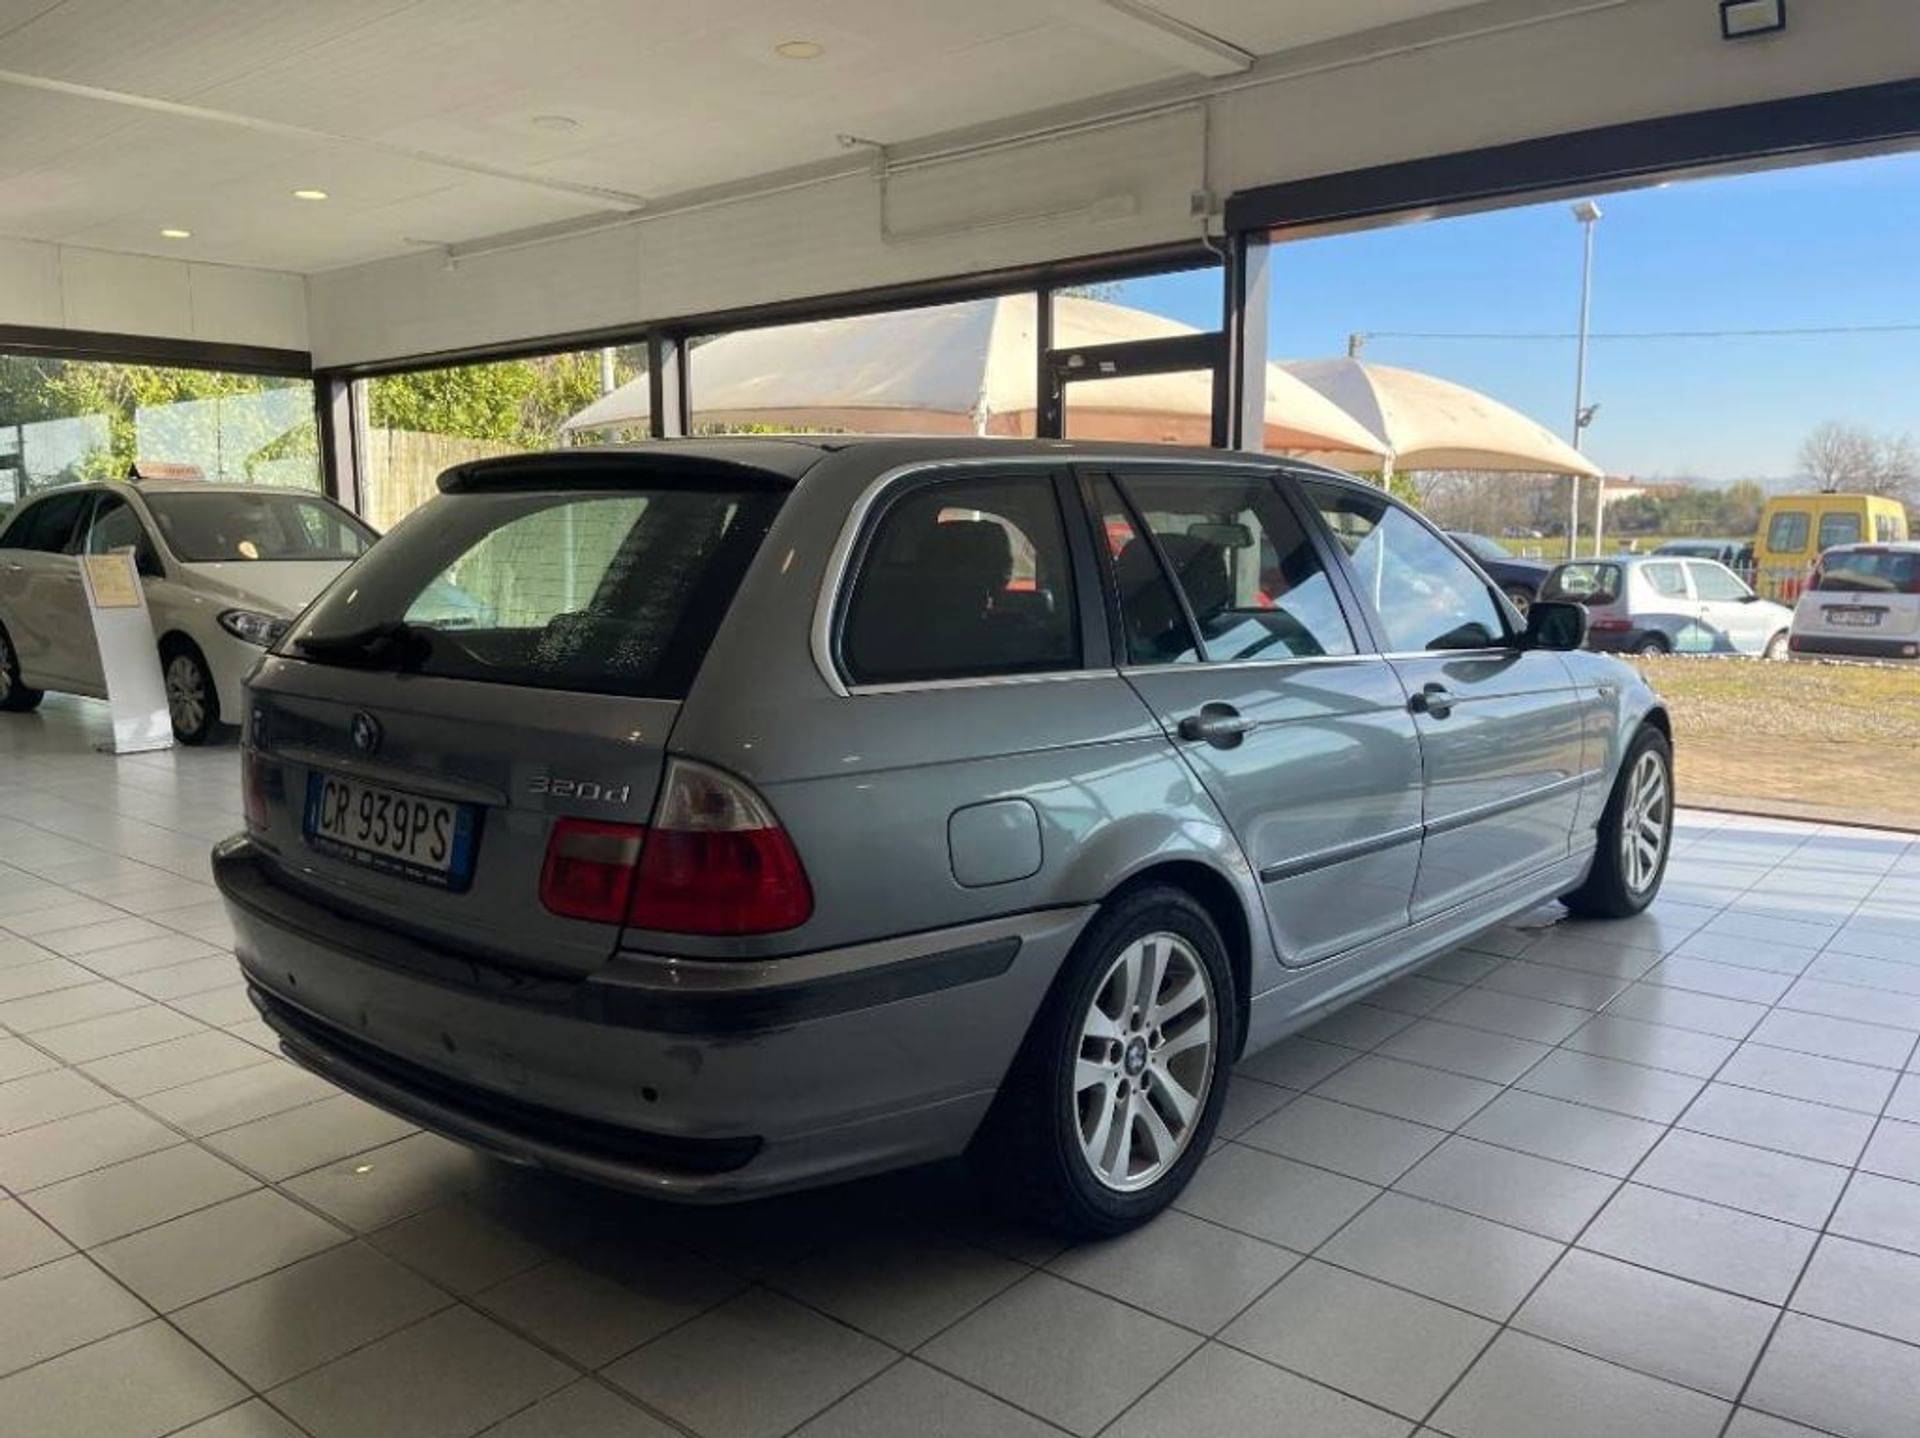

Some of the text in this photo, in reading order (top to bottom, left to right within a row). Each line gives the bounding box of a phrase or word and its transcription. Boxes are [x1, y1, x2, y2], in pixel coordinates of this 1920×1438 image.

[528, 775, 631, 803] 320d
[321, 781, 350, 835] CR
[358, 791, 450, 861] 939PS
